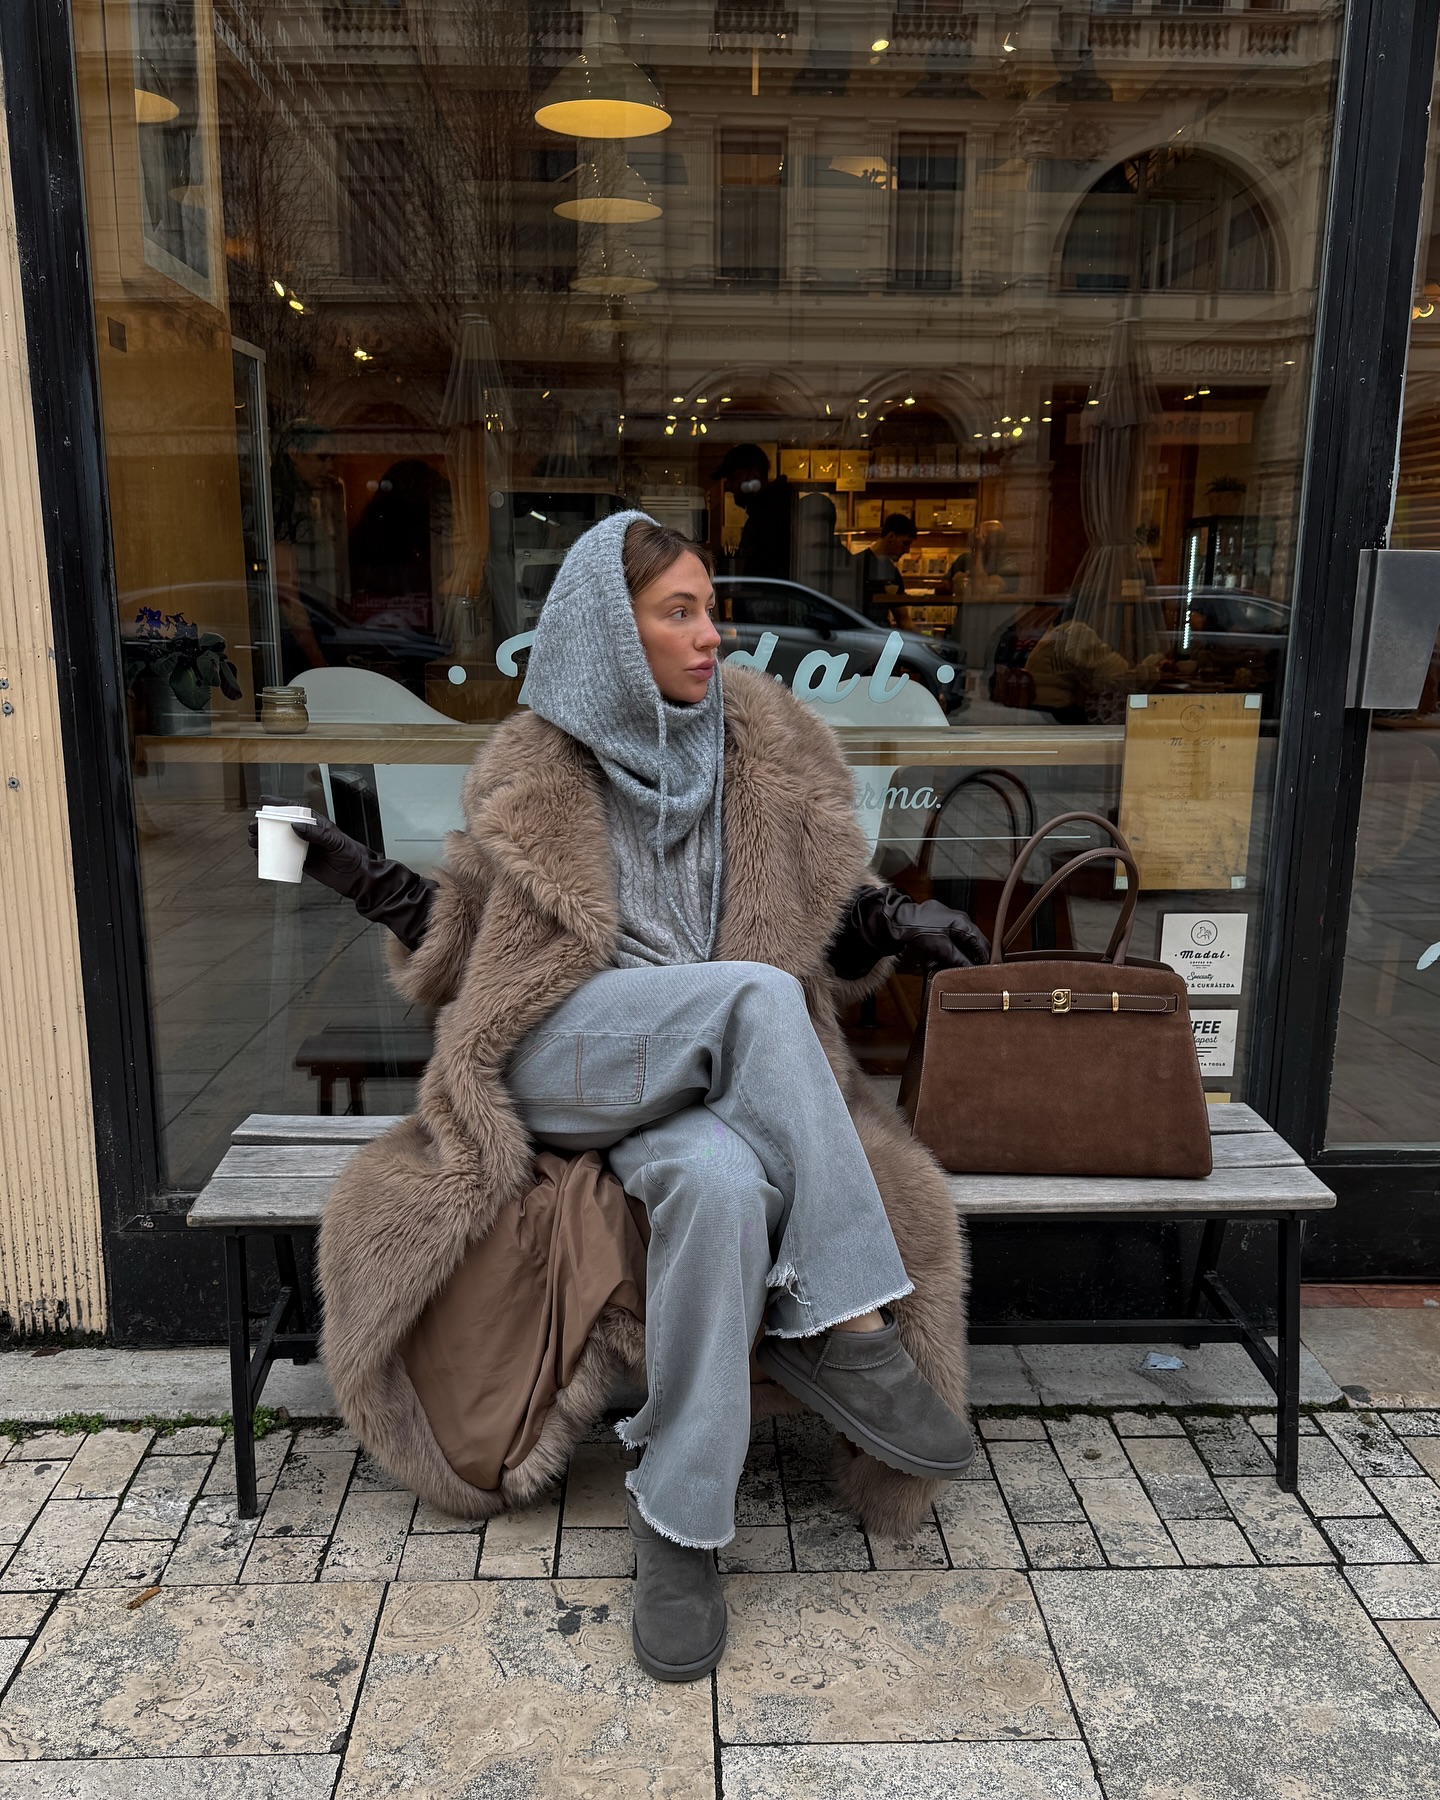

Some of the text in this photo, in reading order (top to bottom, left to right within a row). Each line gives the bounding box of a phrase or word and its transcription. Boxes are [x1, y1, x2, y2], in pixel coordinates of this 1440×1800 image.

[496, 629, 910, 704] dal
[855, 782, 942, 810] rma.
[1179, 950, 1226, 959] Madal
[1191, 1021, 1222, 1034] FEE
[1193, 1035, 1218, 1046] apest
